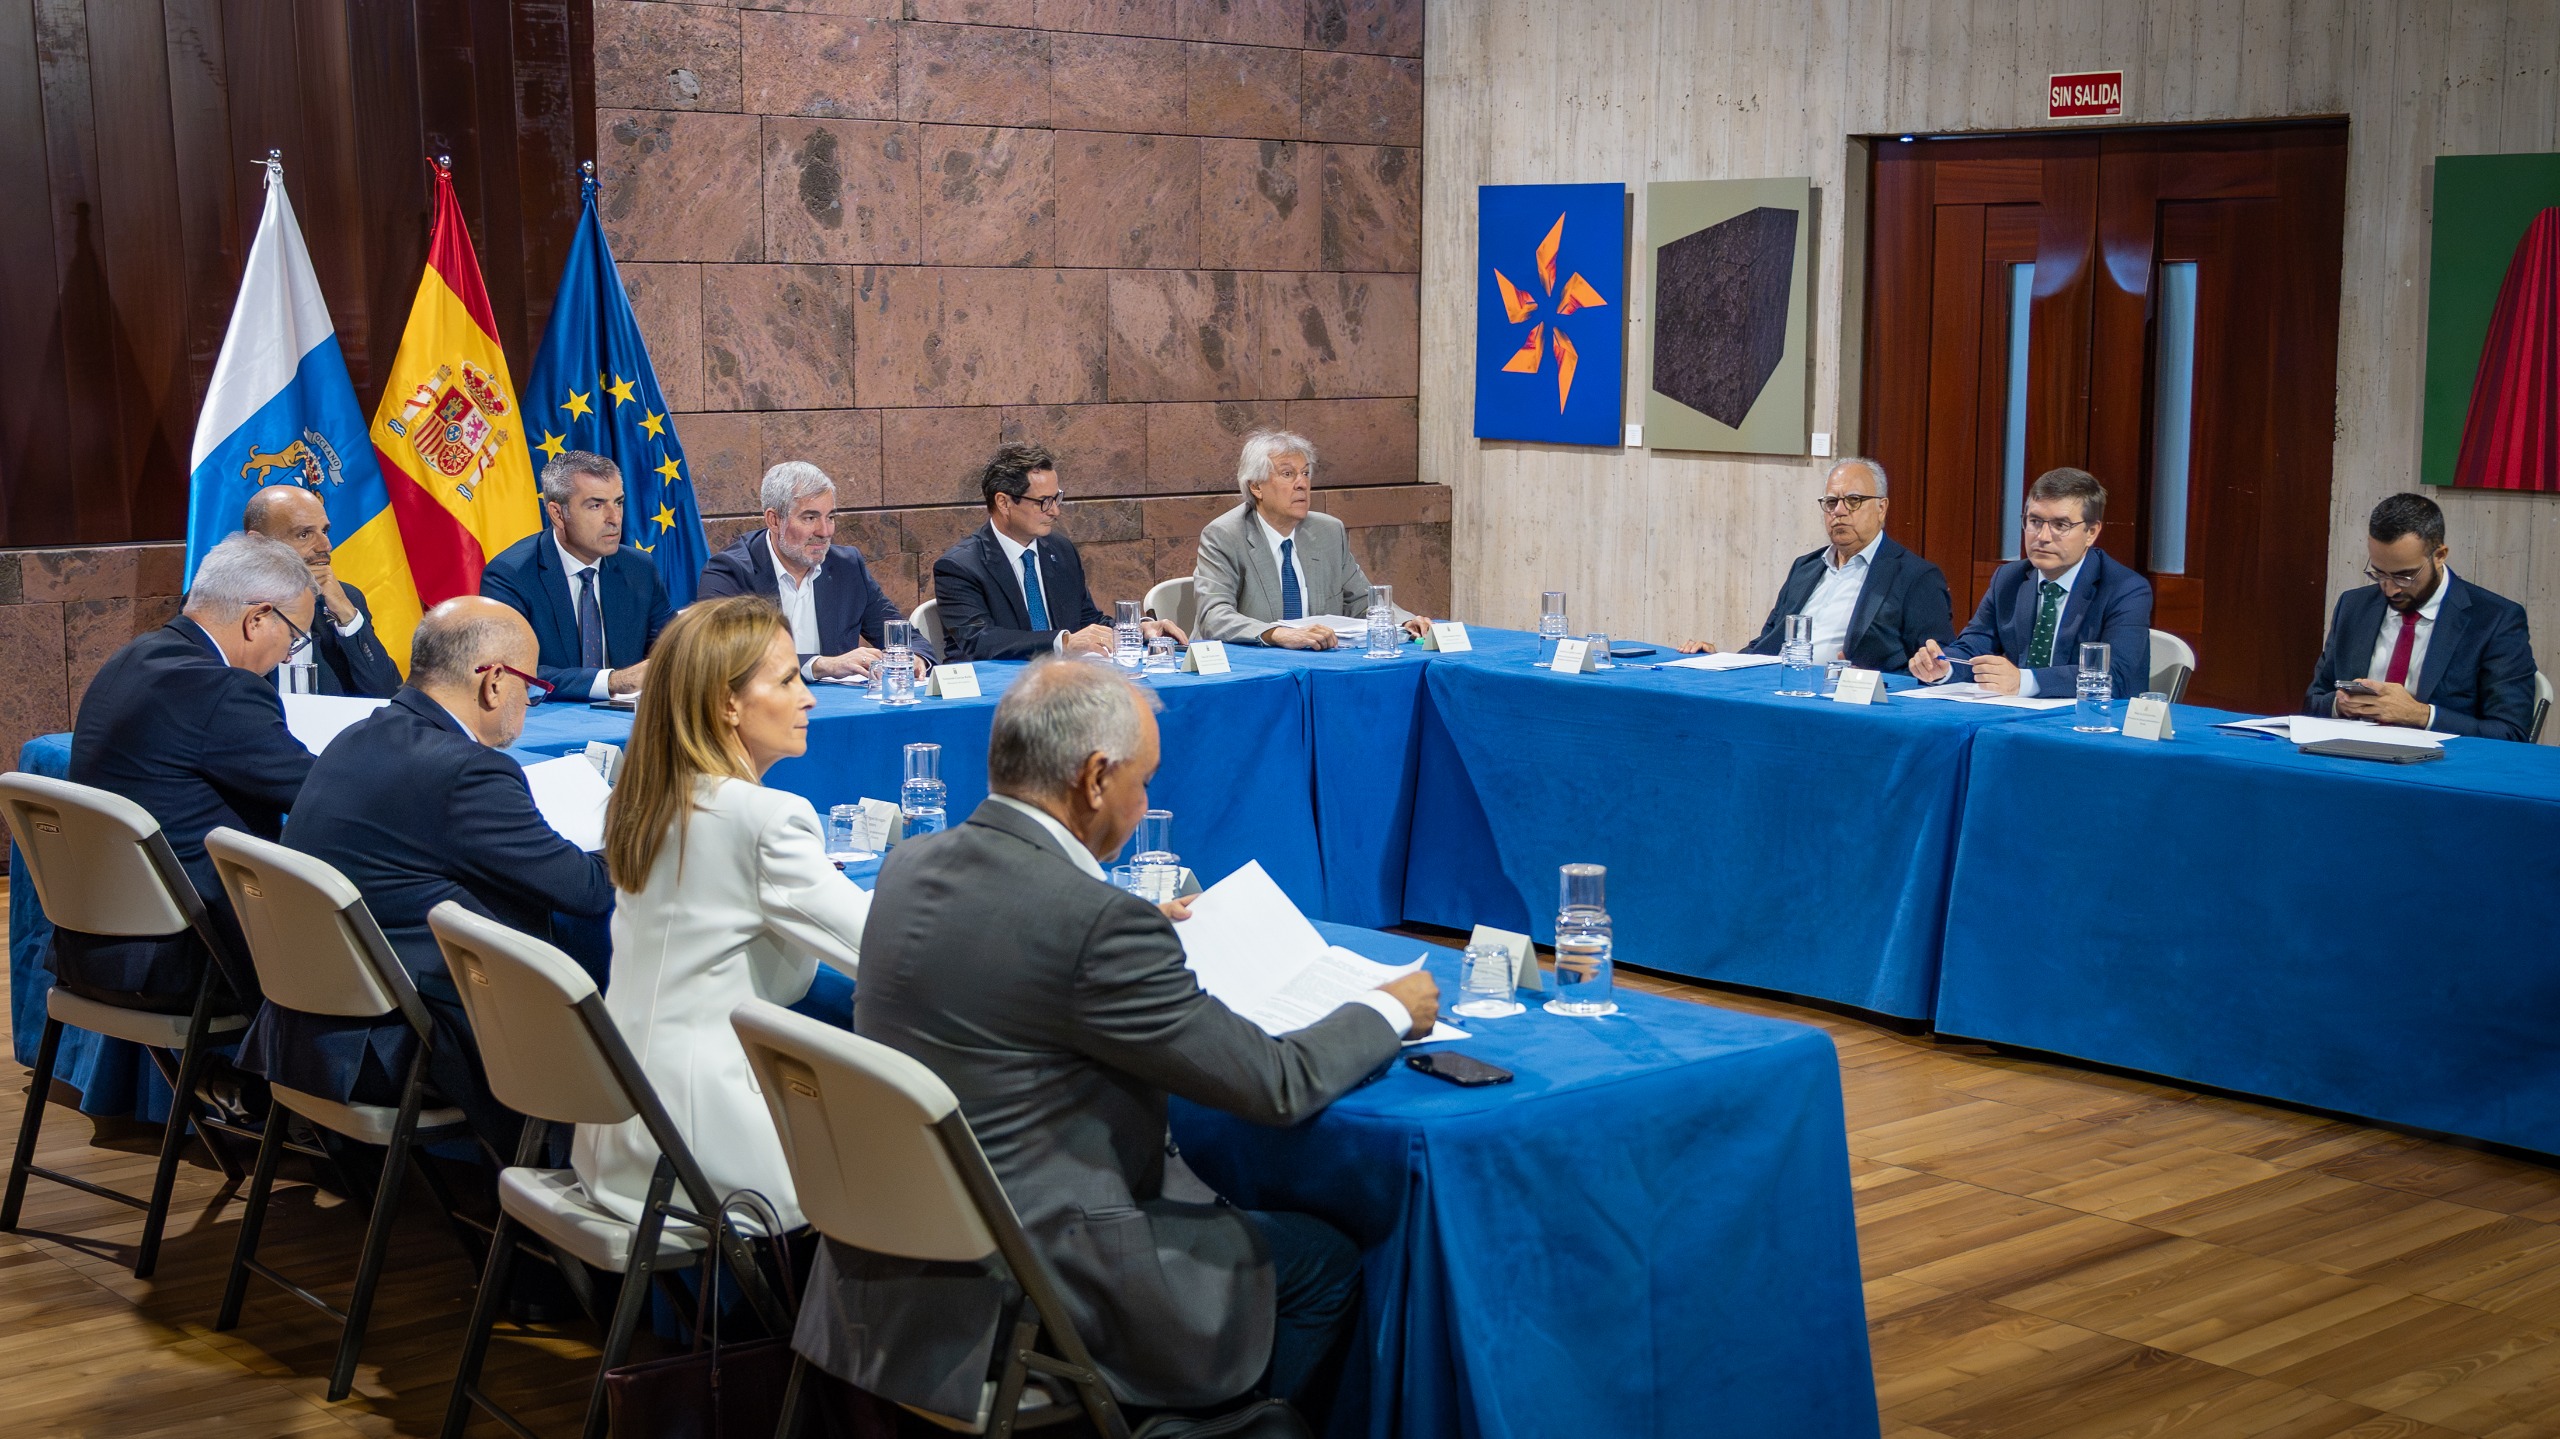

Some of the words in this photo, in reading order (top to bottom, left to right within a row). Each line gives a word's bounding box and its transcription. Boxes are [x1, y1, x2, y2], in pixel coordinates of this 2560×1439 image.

[2051, 85, 2072, 107] SIN
[2074, 83, 2120, 106] SALIDA
[315, 435, 340, 467] OCEANO
